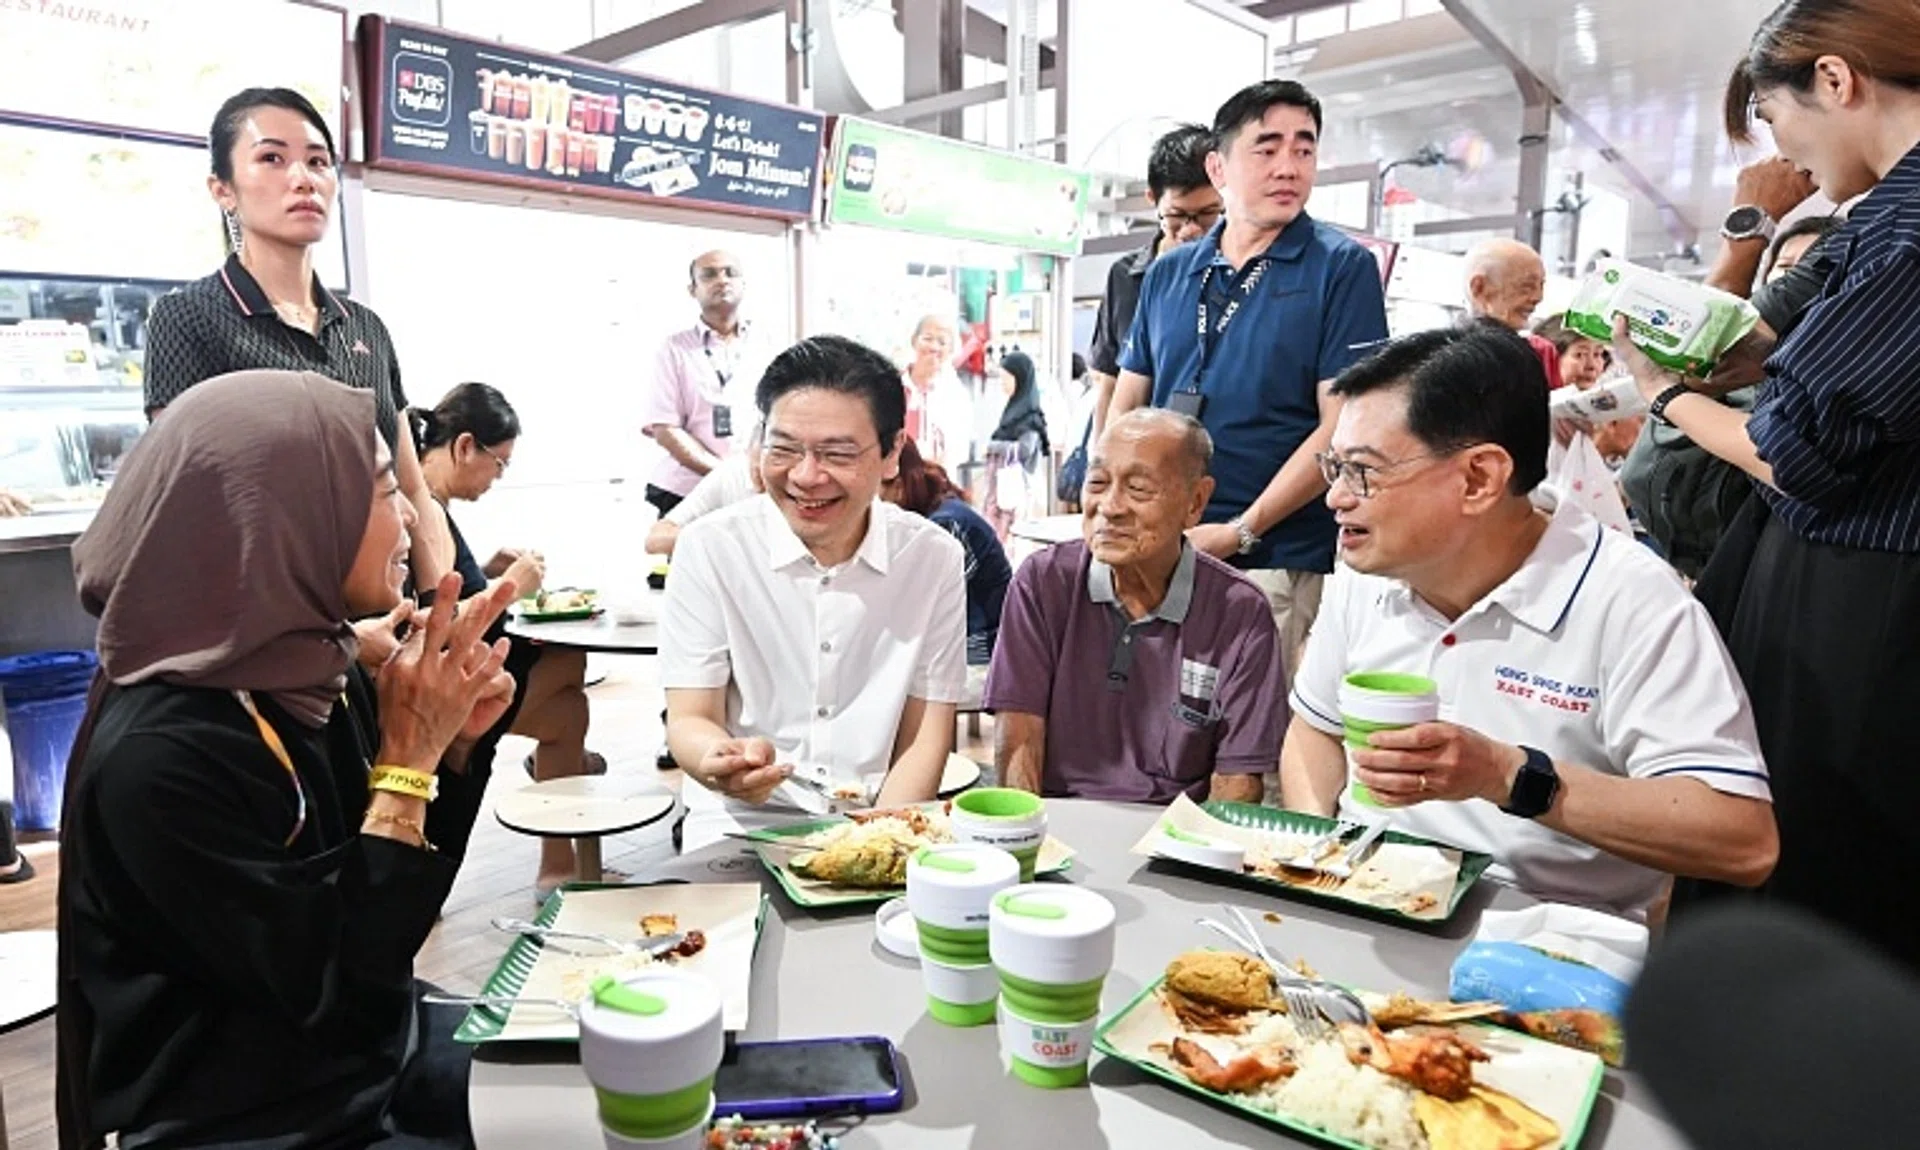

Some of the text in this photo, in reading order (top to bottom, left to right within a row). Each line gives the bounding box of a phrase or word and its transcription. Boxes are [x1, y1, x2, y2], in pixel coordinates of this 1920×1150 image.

[415, 73, 446, 93] DBS
[707, 151, 744, 178] Jom
[745, 158, 811, 188] Minum!
[1496, 680, 1591, 713] EAST COAST
[1032, 1041, 1079, 1056] COAST
